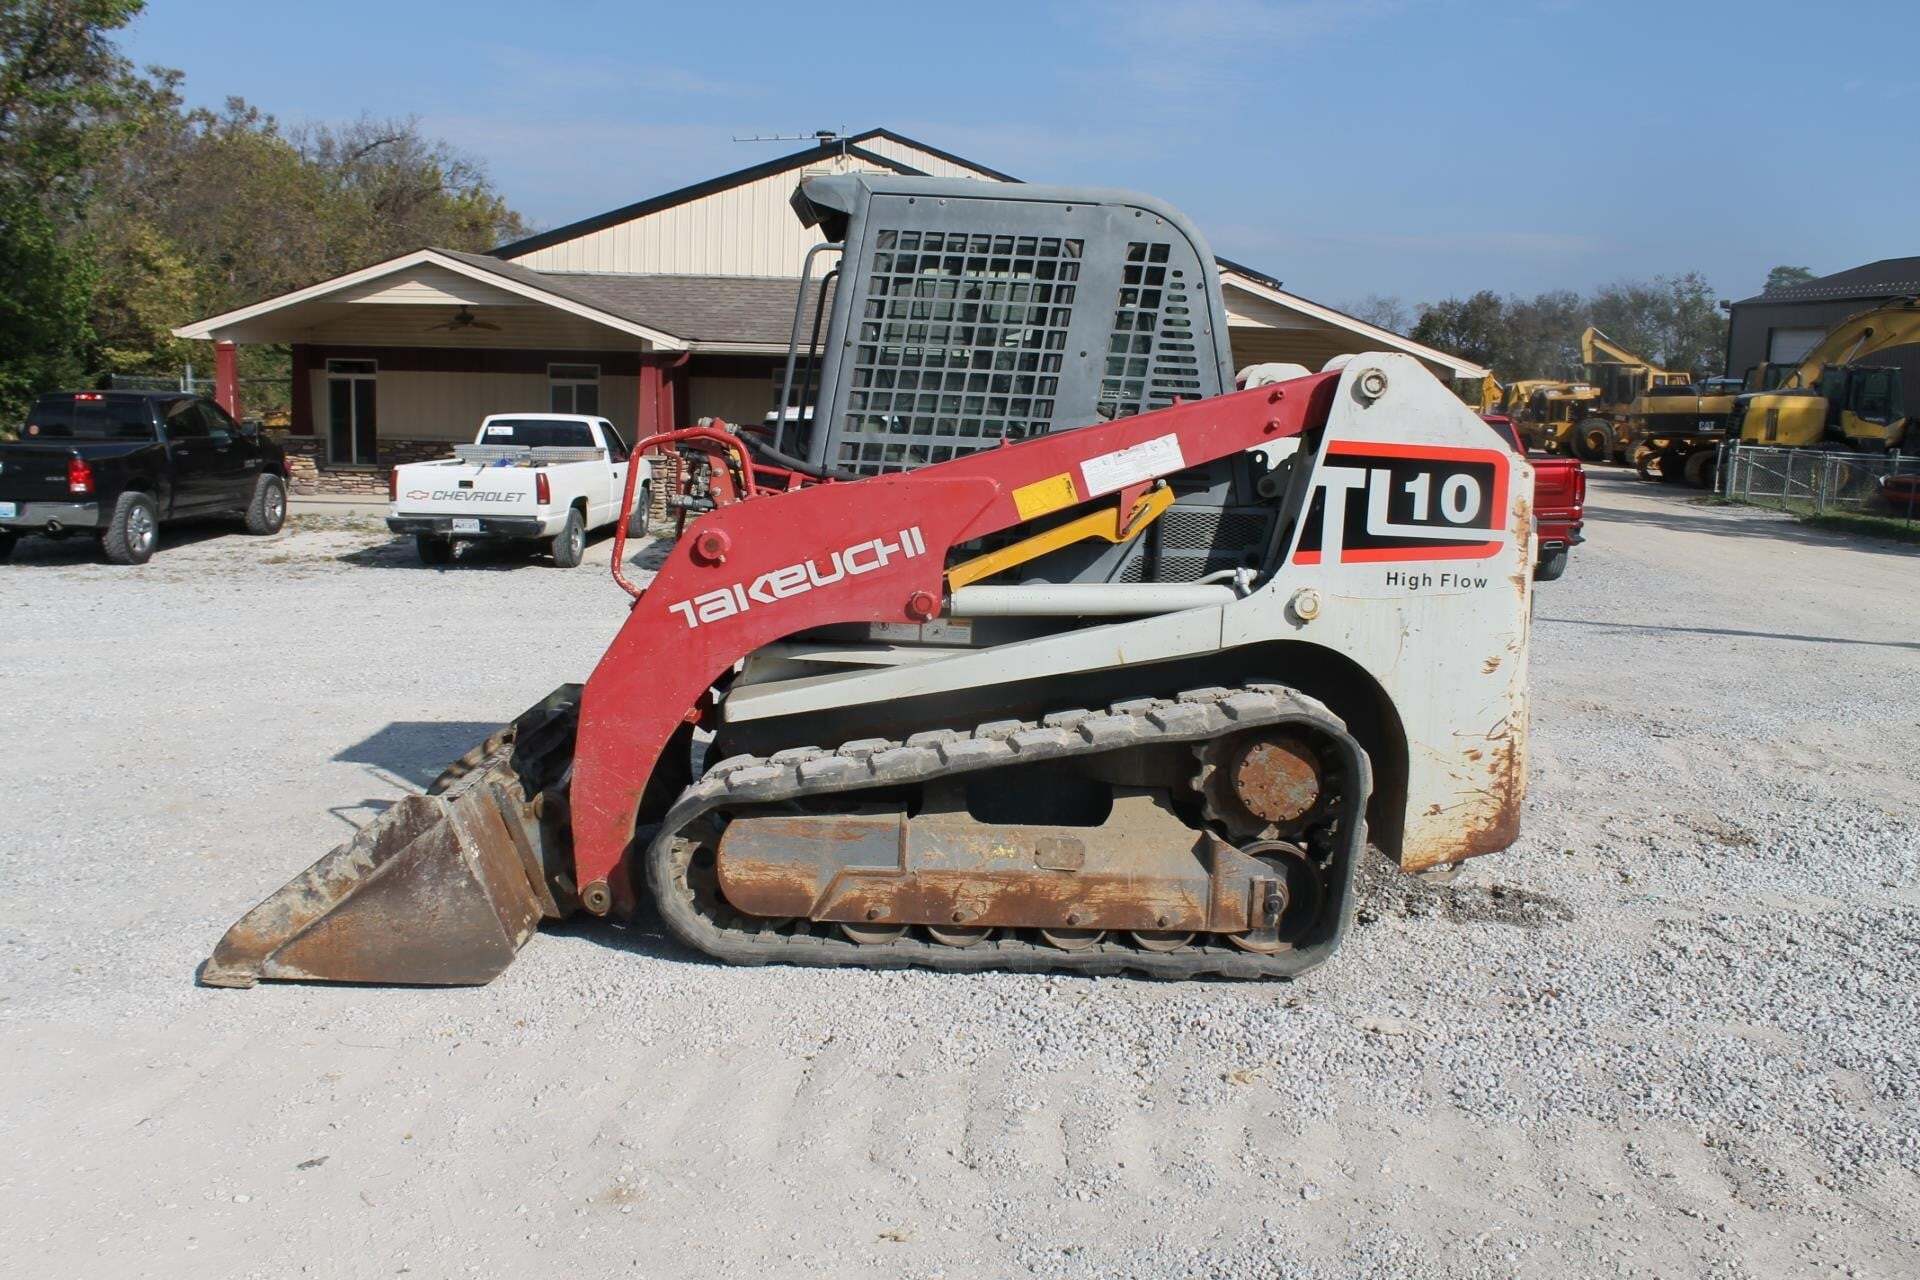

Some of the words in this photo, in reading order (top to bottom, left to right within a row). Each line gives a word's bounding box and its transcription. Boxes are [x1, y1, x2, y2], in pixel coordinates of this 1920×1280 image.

[1698, 421, 1715, 431] CAT
[432, 490, 527, 502] CHEVROLET
[1313, 465, 1505, 564] TL10
[1386, 571, 1432, 590] High
[1440, 573, 1488, 589] Flow
